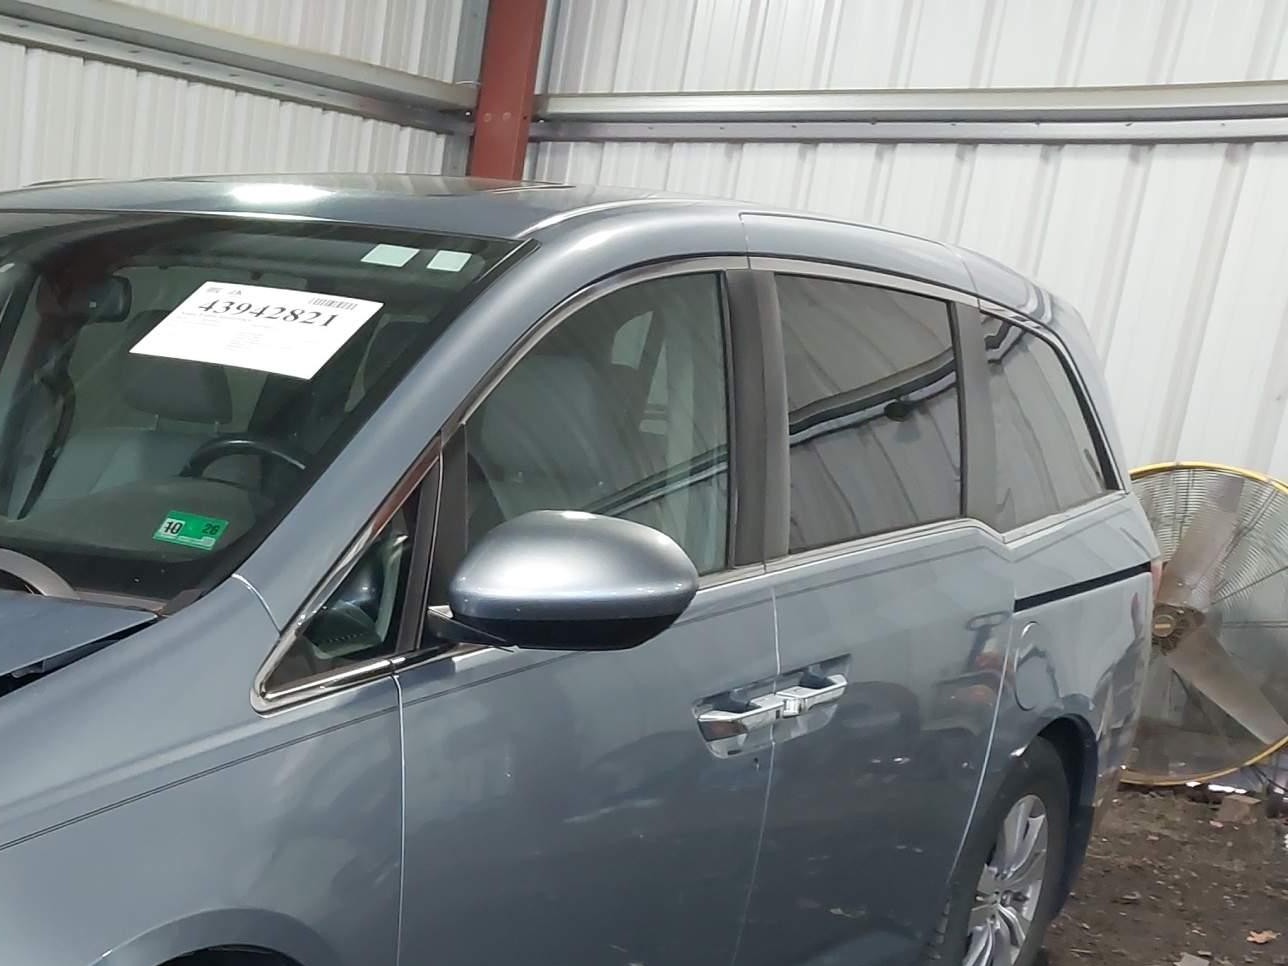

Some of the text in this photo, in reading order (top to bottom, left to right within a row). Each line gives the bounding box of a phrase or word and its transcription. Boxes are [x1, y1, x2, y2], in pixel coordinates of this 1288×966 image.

[198, 299, 339, 327] 43942821
[163, 521, 220, 535] 10 26
